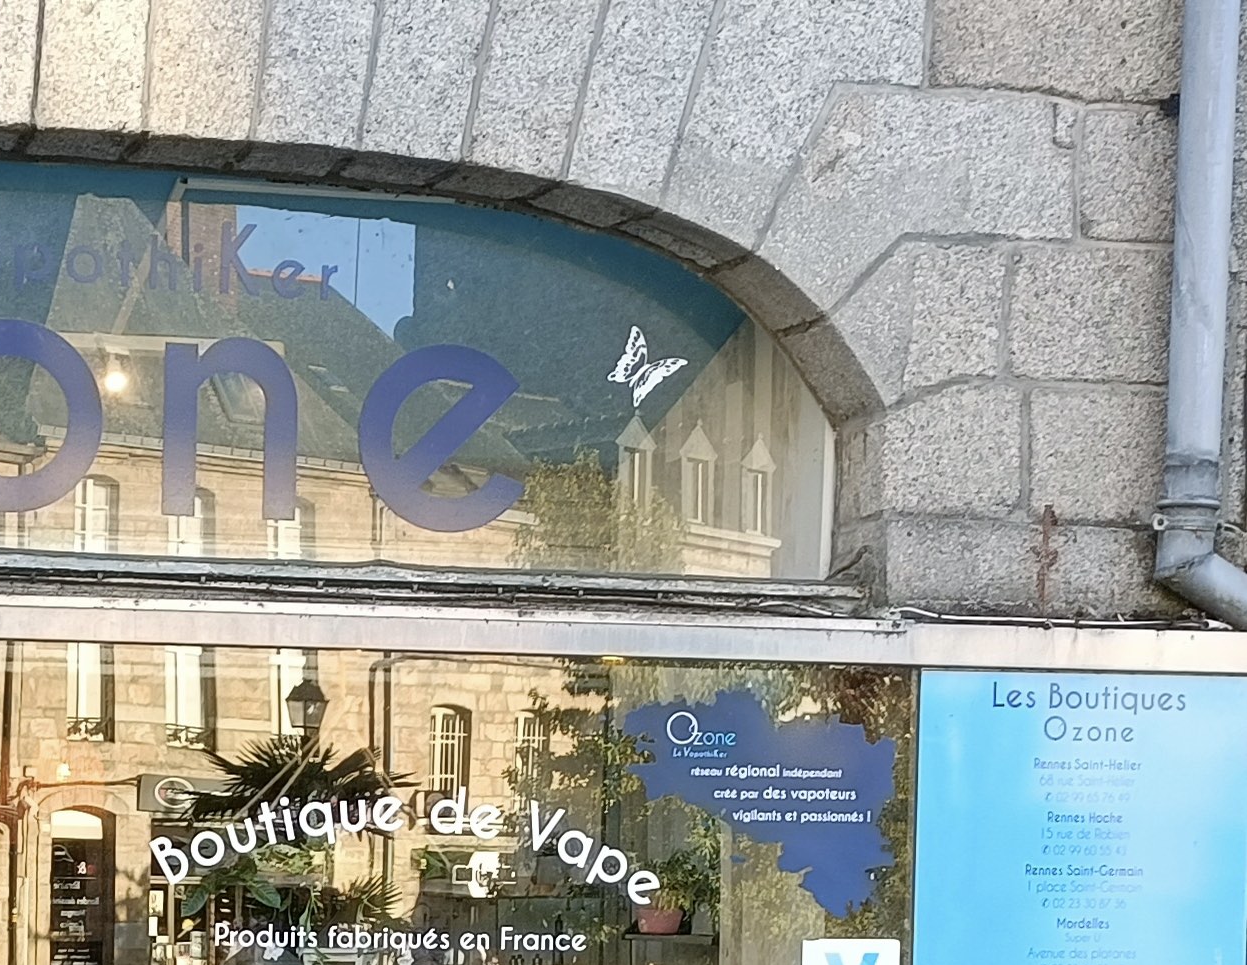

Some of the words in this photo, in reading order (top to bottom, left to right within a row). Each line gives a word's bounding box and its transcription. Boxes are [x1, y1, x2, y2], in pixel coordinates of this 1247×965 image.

[993, 682, 1036, 708] Les
[1049, 682, 1186, 715] Boutiques
[667, 711, 737, 746] Ozone
[1044, 716, 1134, 742] Ozone
[1033, 757, 1072, 770] Rennes
[691, 767, 723, 777] réseau
[725, 765, 780, 779] régional
[783, 767, 843, 779] indépendant
[714, 788, 737, 799] créé
[740, 790, 759, 801] par
[763, 786, 787, 800] des
[791, 788, 857, 802] vapoteurs
[732, 809, 782, 823] vigilants
[785, 812, 797, 822] et
[800, 810, 864, 824] passionnés
[1047, 811, 1085, 823] Rennes
[1089, 812, 1123, 823] Hoche
[149, 794, 405, 886] Boutique
[430, 785, 503, 839] de
[528, 800, 661, 905] Vape
[1025, 864, 1063, 876] Rennes
[1067, 864, 1143, 876] Saint-Germain
[1056, 918, 1110, 929] Mordelles
[214, 922, 318, 949] Produits
[327, 924, 450, 961] fabriqués
[459, 931, 490, 951] en
[500, 925, 588, 952] France
